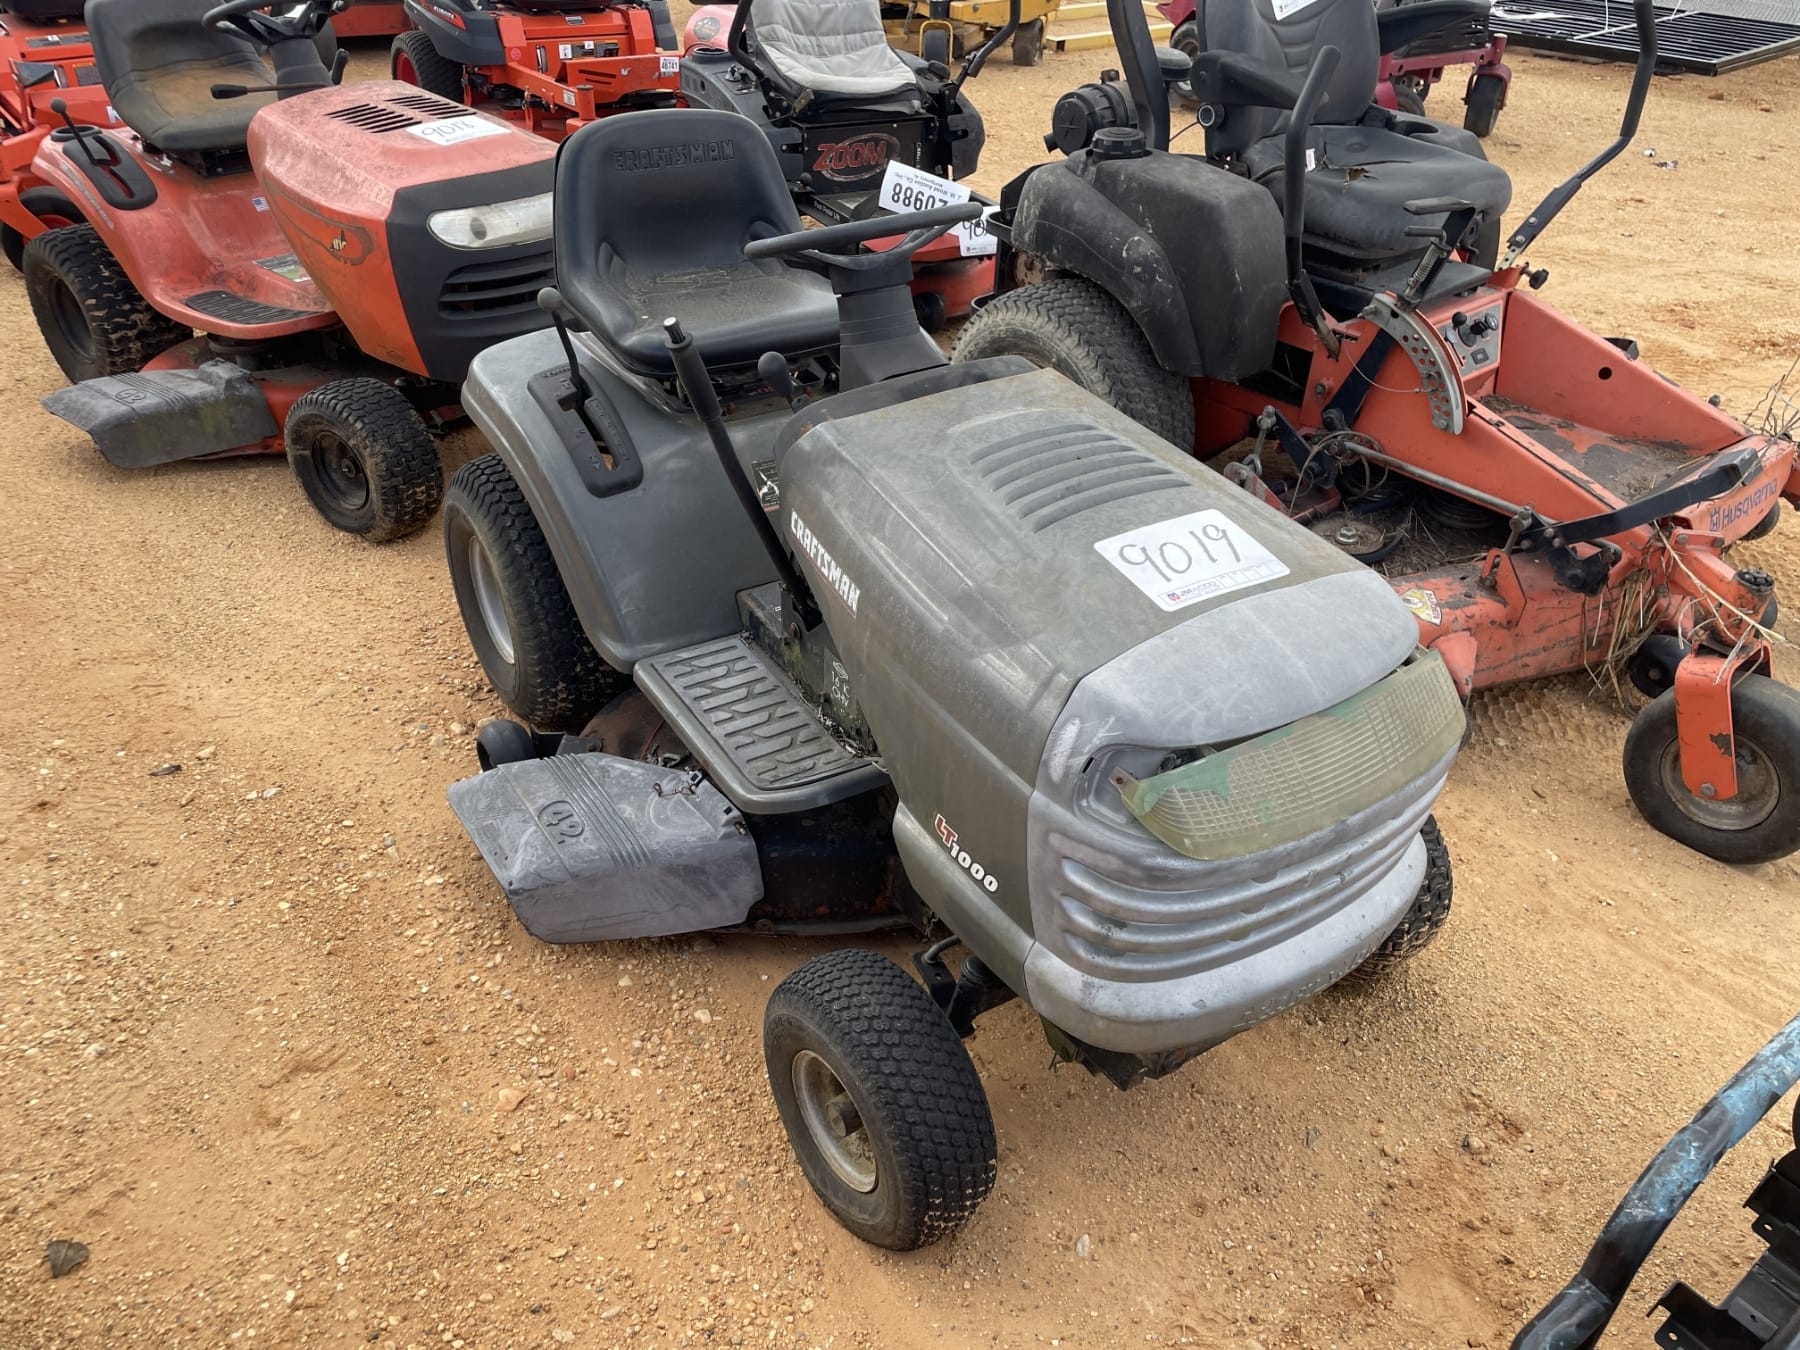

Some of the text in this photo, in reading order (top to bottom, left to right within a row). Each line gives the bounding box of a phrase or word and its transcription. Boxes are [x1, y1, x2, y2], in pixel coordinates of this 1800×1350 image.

[613, 140, 736, 172] CRAFTSMAN
[813, 141, 887, 171] ZOOM
[1721, 478, 1777, 530] Husqvarna
[791, 511, 861, 612] CRAFTSMAN
[1118, 524, 1241, 582] 9019
